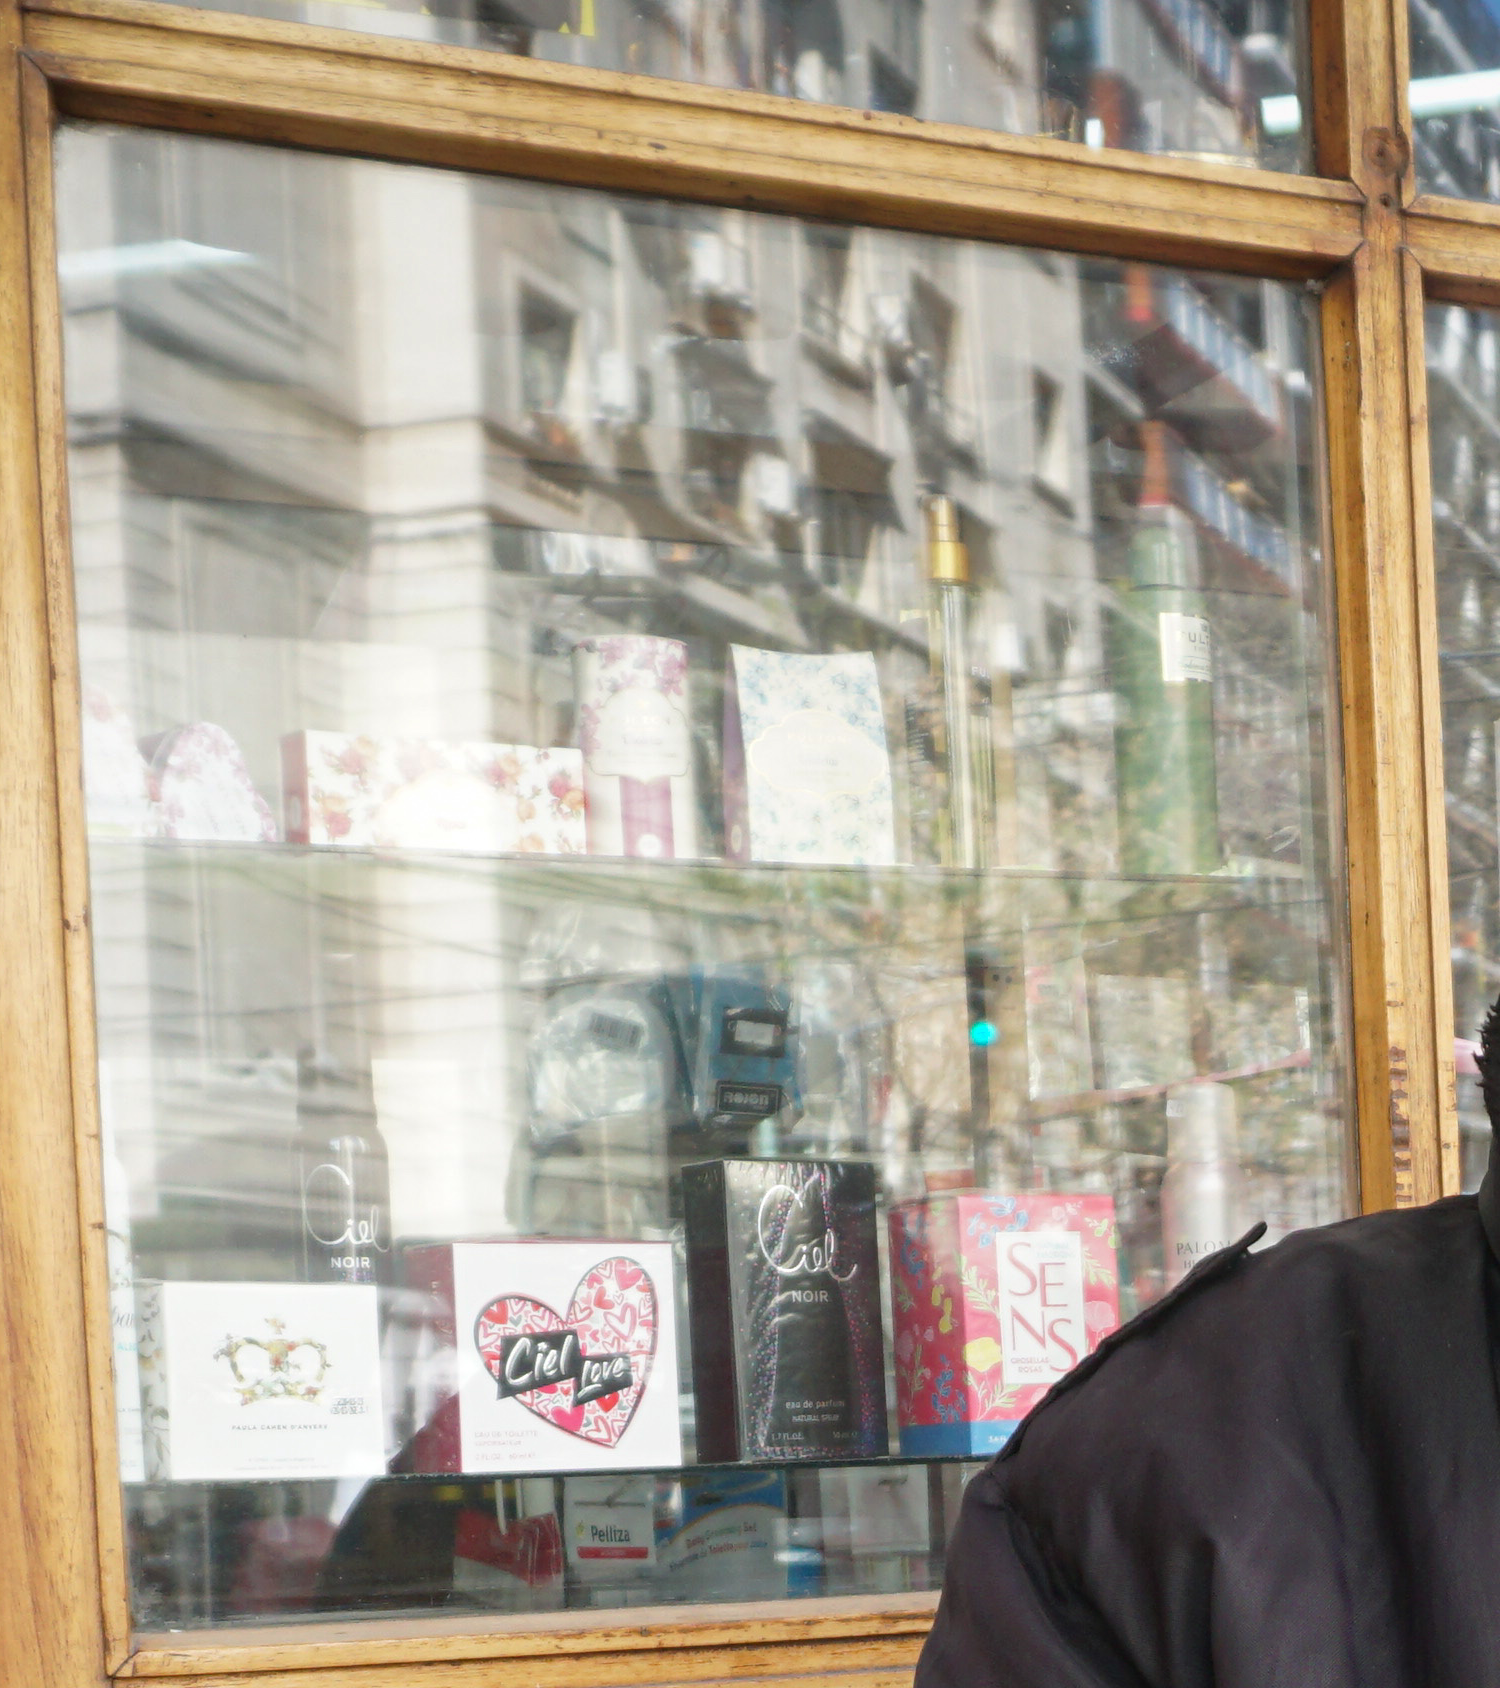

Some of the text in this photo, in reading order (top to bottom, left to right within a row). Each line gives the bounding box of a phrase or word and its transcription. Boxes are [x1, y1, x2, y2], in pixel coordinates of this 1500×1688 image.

[302, 1163, 391, 1253] Ciel
[757, 1184, 858, 1282] Ciel
[331, 1256, 371, 1269] NOIR
[791, 1290, 829, 1303] NOIR
[505, 1335, 573, 1386] Ciel
[1018, 1365, 1043, 1373] ROSAS
[576, 1357, 625, 1399] Love
[785, 1399, 845, 1411] eau de parfum
[231, 1423, 258, 1431] PAULA
